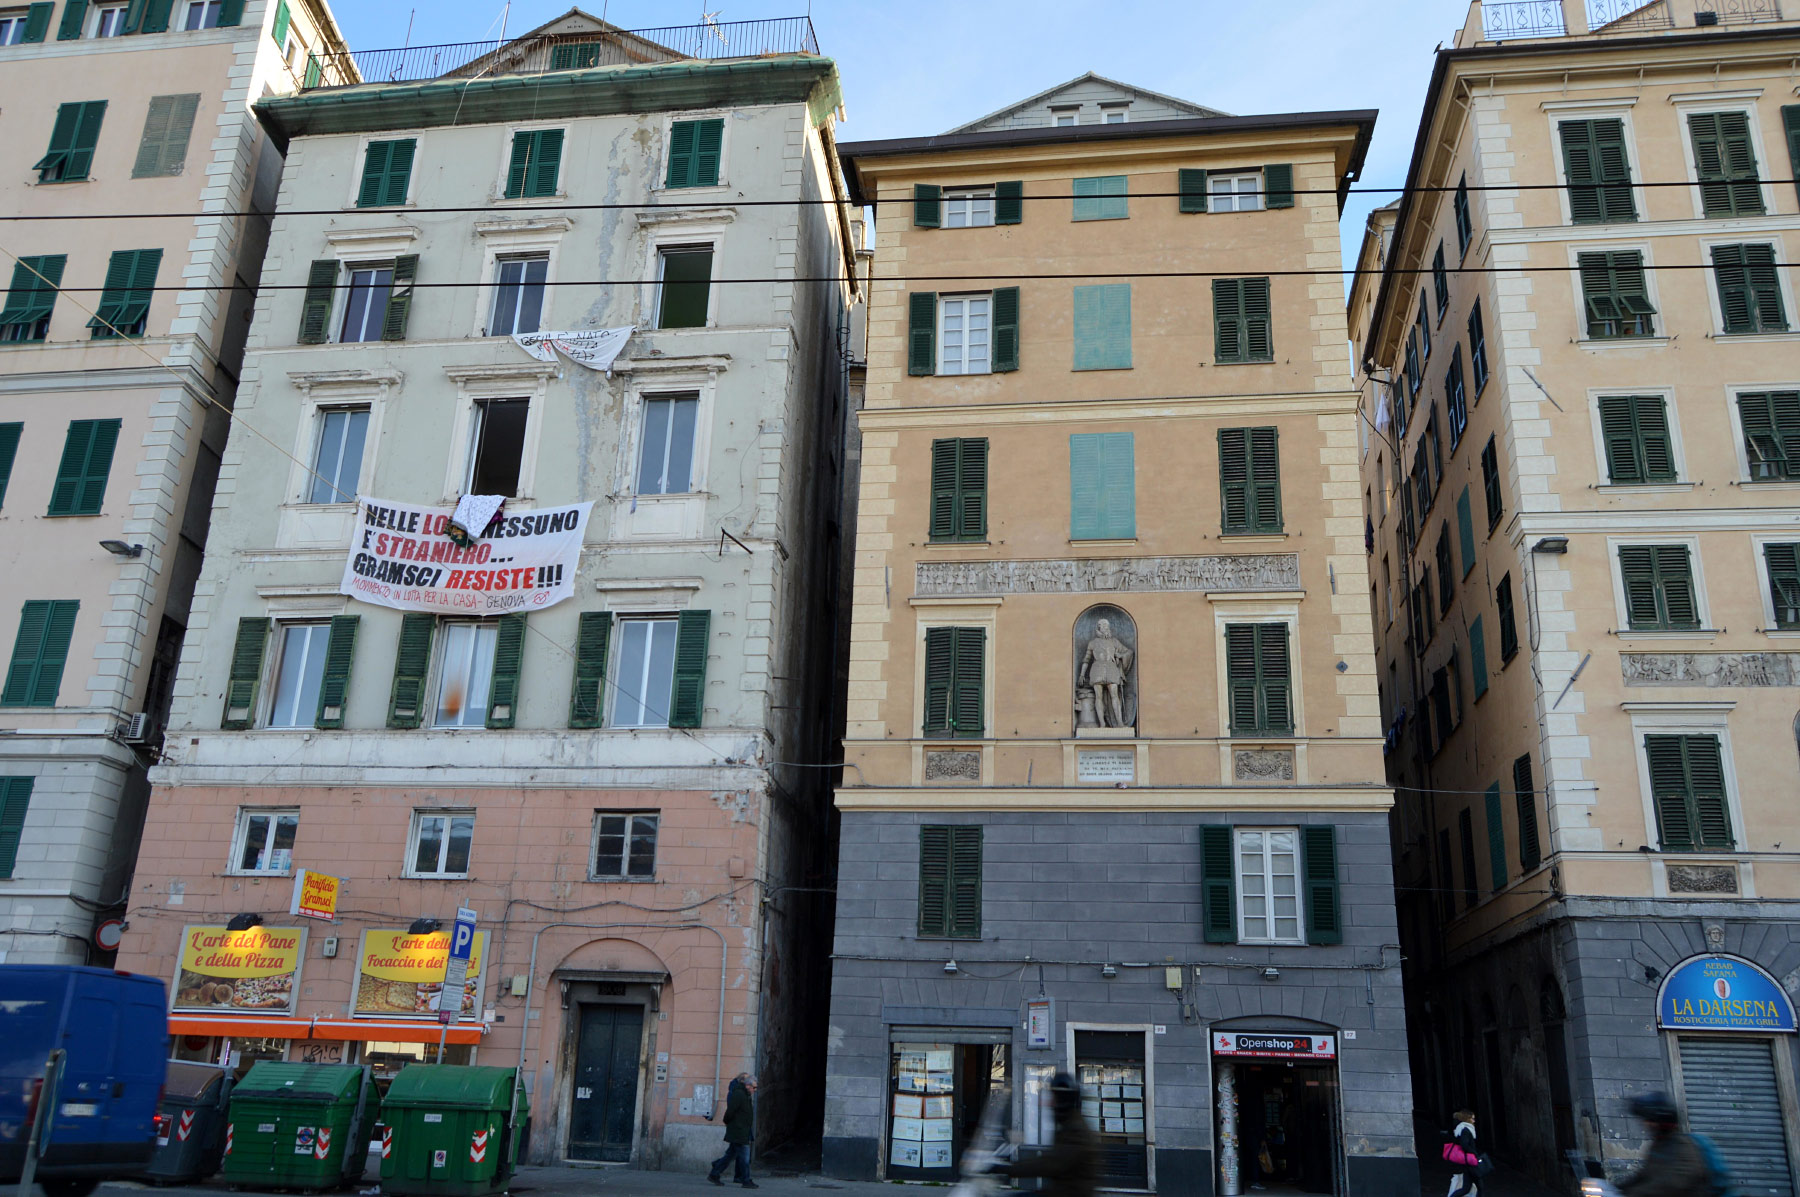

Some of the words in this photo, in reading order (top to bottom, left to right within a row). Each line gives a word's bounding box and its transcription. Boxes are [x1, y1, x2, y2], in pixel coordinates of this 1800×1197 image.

[365, 504, 421, 533] NELLE
[353, 552, 442, 588] GRAMSCI
[352, 576, 391, 598] MOVIMENTO
[393, 590, 402, 600] IN
[404, 589, 421, 601] LOTTA
[424, 590, 437, 603] PER
[440, 592, 448, 605] LA
[486, 595, 525, 608] GENOVA
[305, 875, 334, 893] Panificio
[304, 890, 332, 907] Gramsci
[192, 931, 232, 951] L'arte
[233, 933, 257, 948] del
[259, 933, 296, 949] Pane
[392, 936, 425, 952] L'arte
[454, 924, 471, 955] P
[195, 955, 204, 967] e
[205, 952, 242, 967] della
[245, 952, 285, 968] Pizza
[367, 954, 415, 968] Focaccia
[417, 958, 424, 968] e
[425, 957, 445, 969] dei
[1705, 962, 1733, 970] KEBAB
[1703, 970, 1737, 978] SAFANA
[1672, 998, 1695, 1015] LA
[1698, 999, 1779, 1018] DARSENA
[1673, 1016, 1730, 1025] ROSTICCERIA
[1730, 1017, 1754, 1025] PIZZA
[1755, 1018, 1781, 1026] GRILL
[1240, 1037, 1308, 1050] Openshop24
